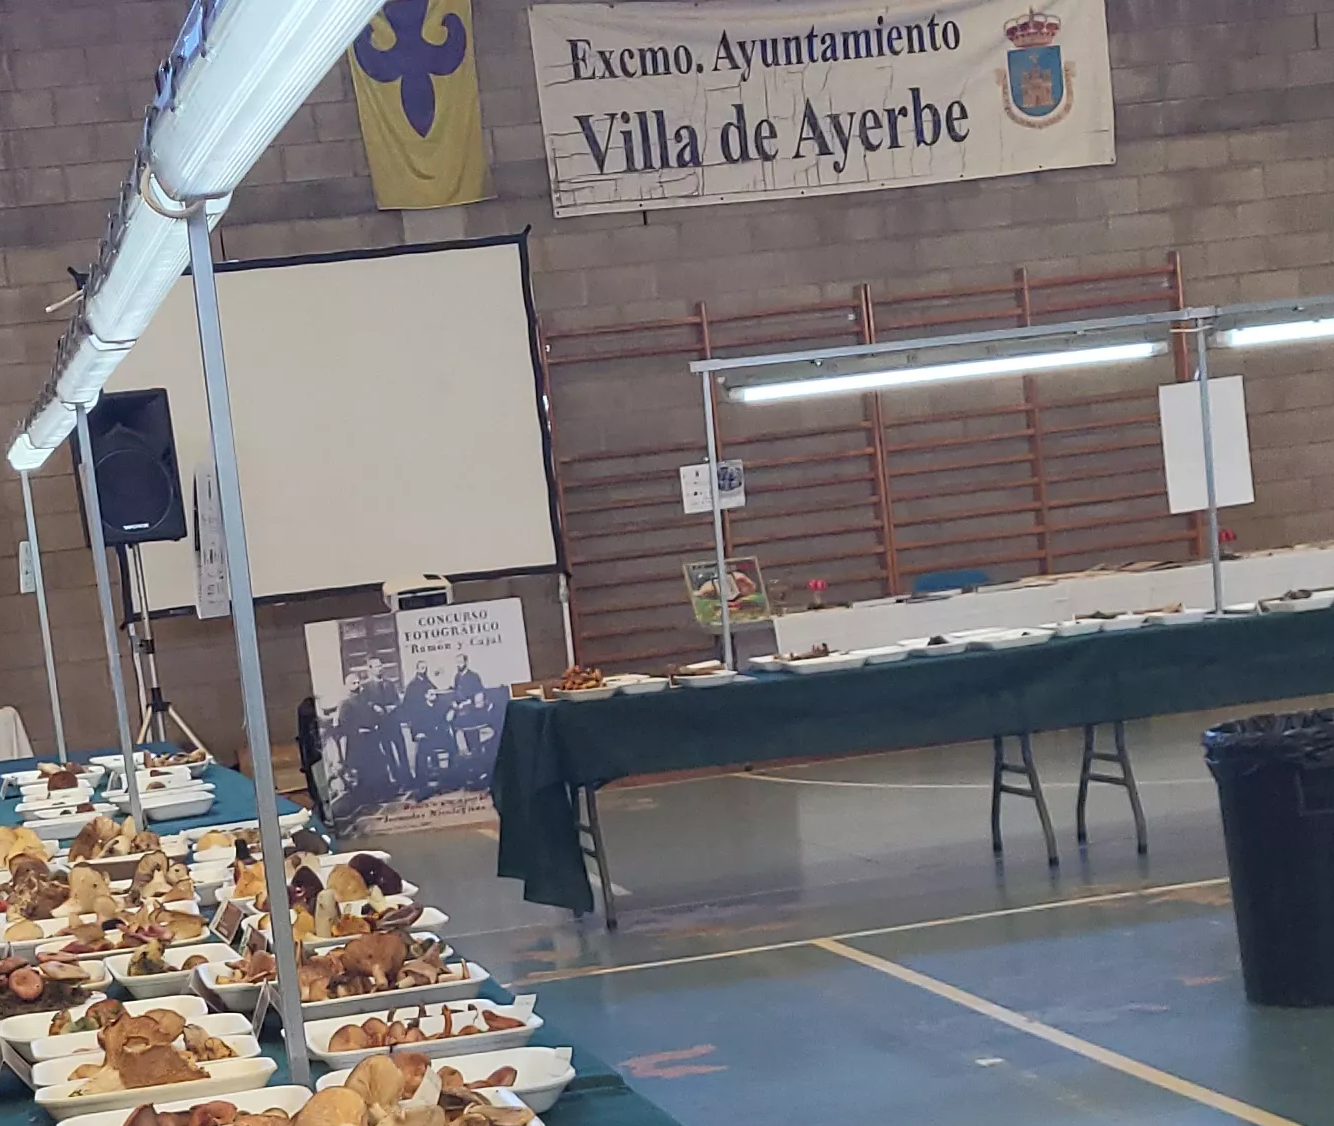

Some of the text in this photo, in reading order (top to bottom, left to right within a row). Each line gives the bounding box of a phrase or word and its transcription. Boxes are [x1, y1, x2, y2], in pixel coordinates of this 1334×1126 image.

[567, 15, 961, 82] Excmo. Ayuntamiento
[574, 87, 970, 174] Villa de Ayerbe
[404, 621, 499, 642] FOTOGRÁFICO
[418, 609, 488, 626] CONCURSO
